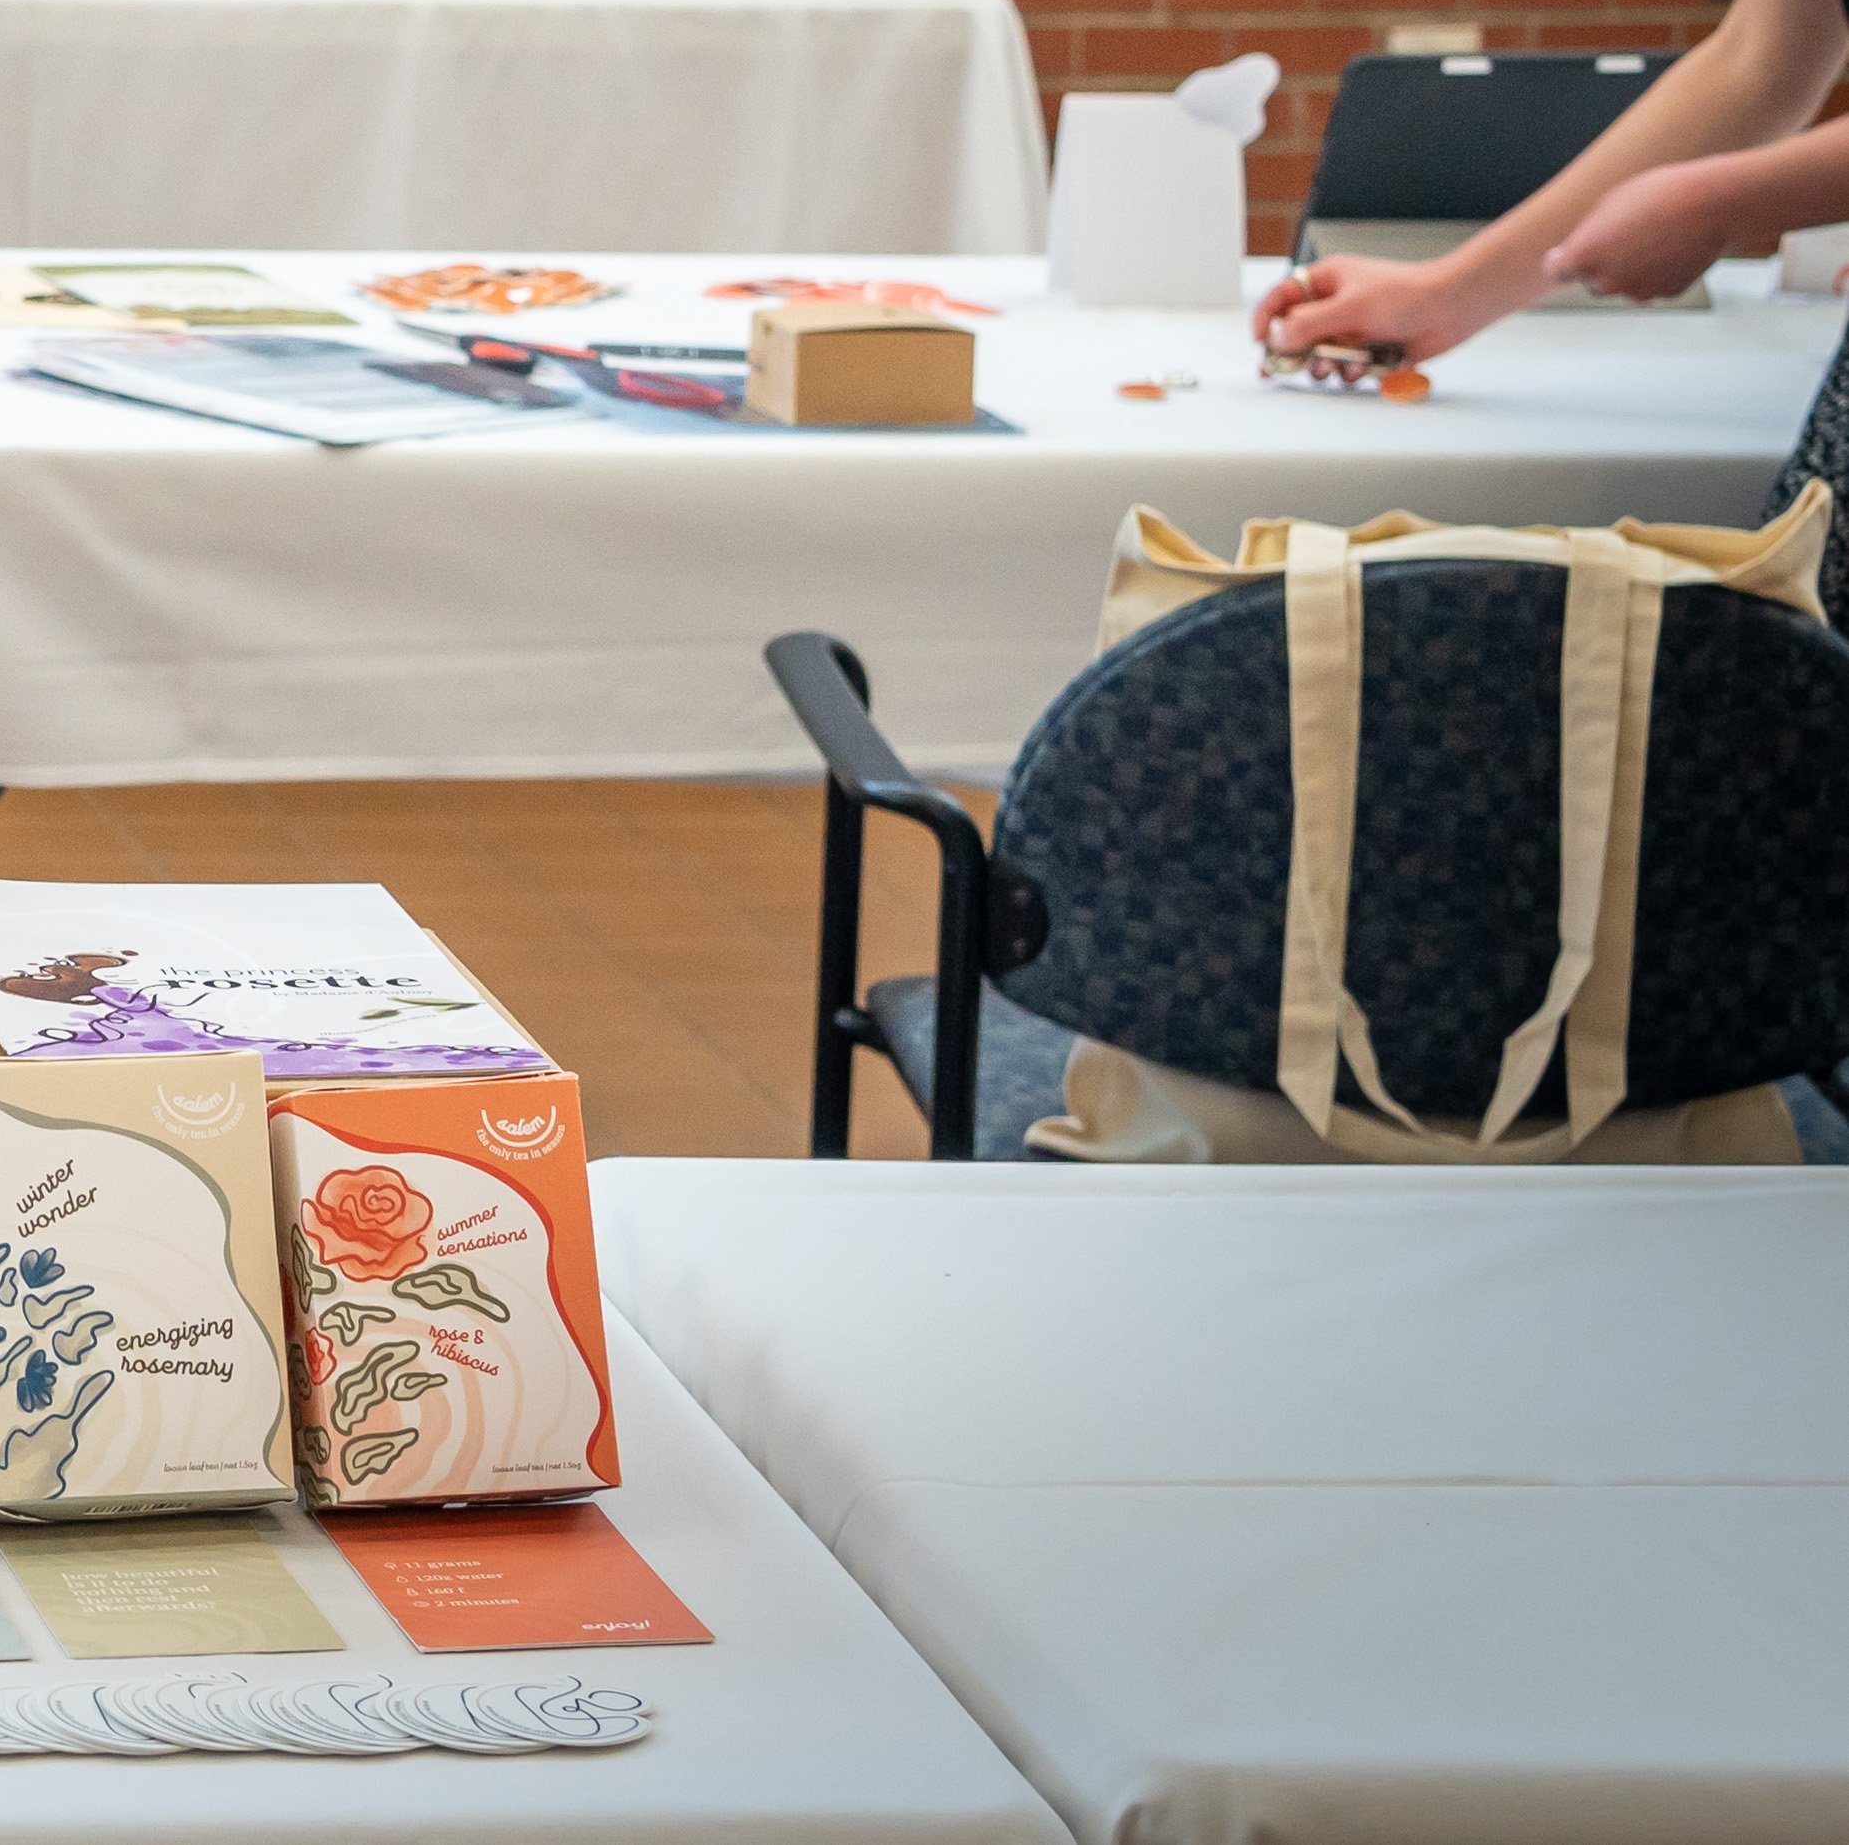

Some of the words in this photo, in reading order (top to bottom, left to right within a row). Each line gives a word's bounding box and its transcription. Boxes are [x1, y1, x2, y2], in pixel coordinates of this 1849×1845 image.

[160, 967, 211, 976] the
[224, 967, 359, 977] princess
[159, 976, 422, 989] rosette
[173, 1092, 225, 1113] salem
[496, 1116, 546, 1136] salem
[476, 1128, 490, 1147] the
[488, 1143, 512, 1161] only
[513, 1151, 529, 1161] tea
[529, 1149, 542, 1159] in
[16, 1159, 75, 1214] winter
[17, 1186, 98, 1238] wonder
[437, 1205, 499, 1241] summer
[437, 1228, 528, 1257] sensations
[116, 1317, 234, 1352] energizing
[428, 1325, 470, 1343] rose
[473, 1329, 485, 1345] &
[430, 1336, 500, 1377] hibiscus
[120, 1355, 234, 1383] rosemary
[163, 1462, 187, 1472] loose
[189, 1460, 205, 1472] leaf
[61, 1572, 107, 1581] how
[114, 1566, 218, 1579] beautiful
[427, 1560, 482, 1570] grams
[112, 1579, 135, 1587] to
[141, 1578, 169, 1587] do
[455, 1572, 504, 1581] water
[72, 1586, 163, 1596] nothing
[167, 1584, 211, 1594] and
[76, 1595, 129, 1605] then
[135, 1594, 179, 1603] rest
[449, 1598, 520, 1607] minutes
[581, 1619, 651, 1632] enjoy!
